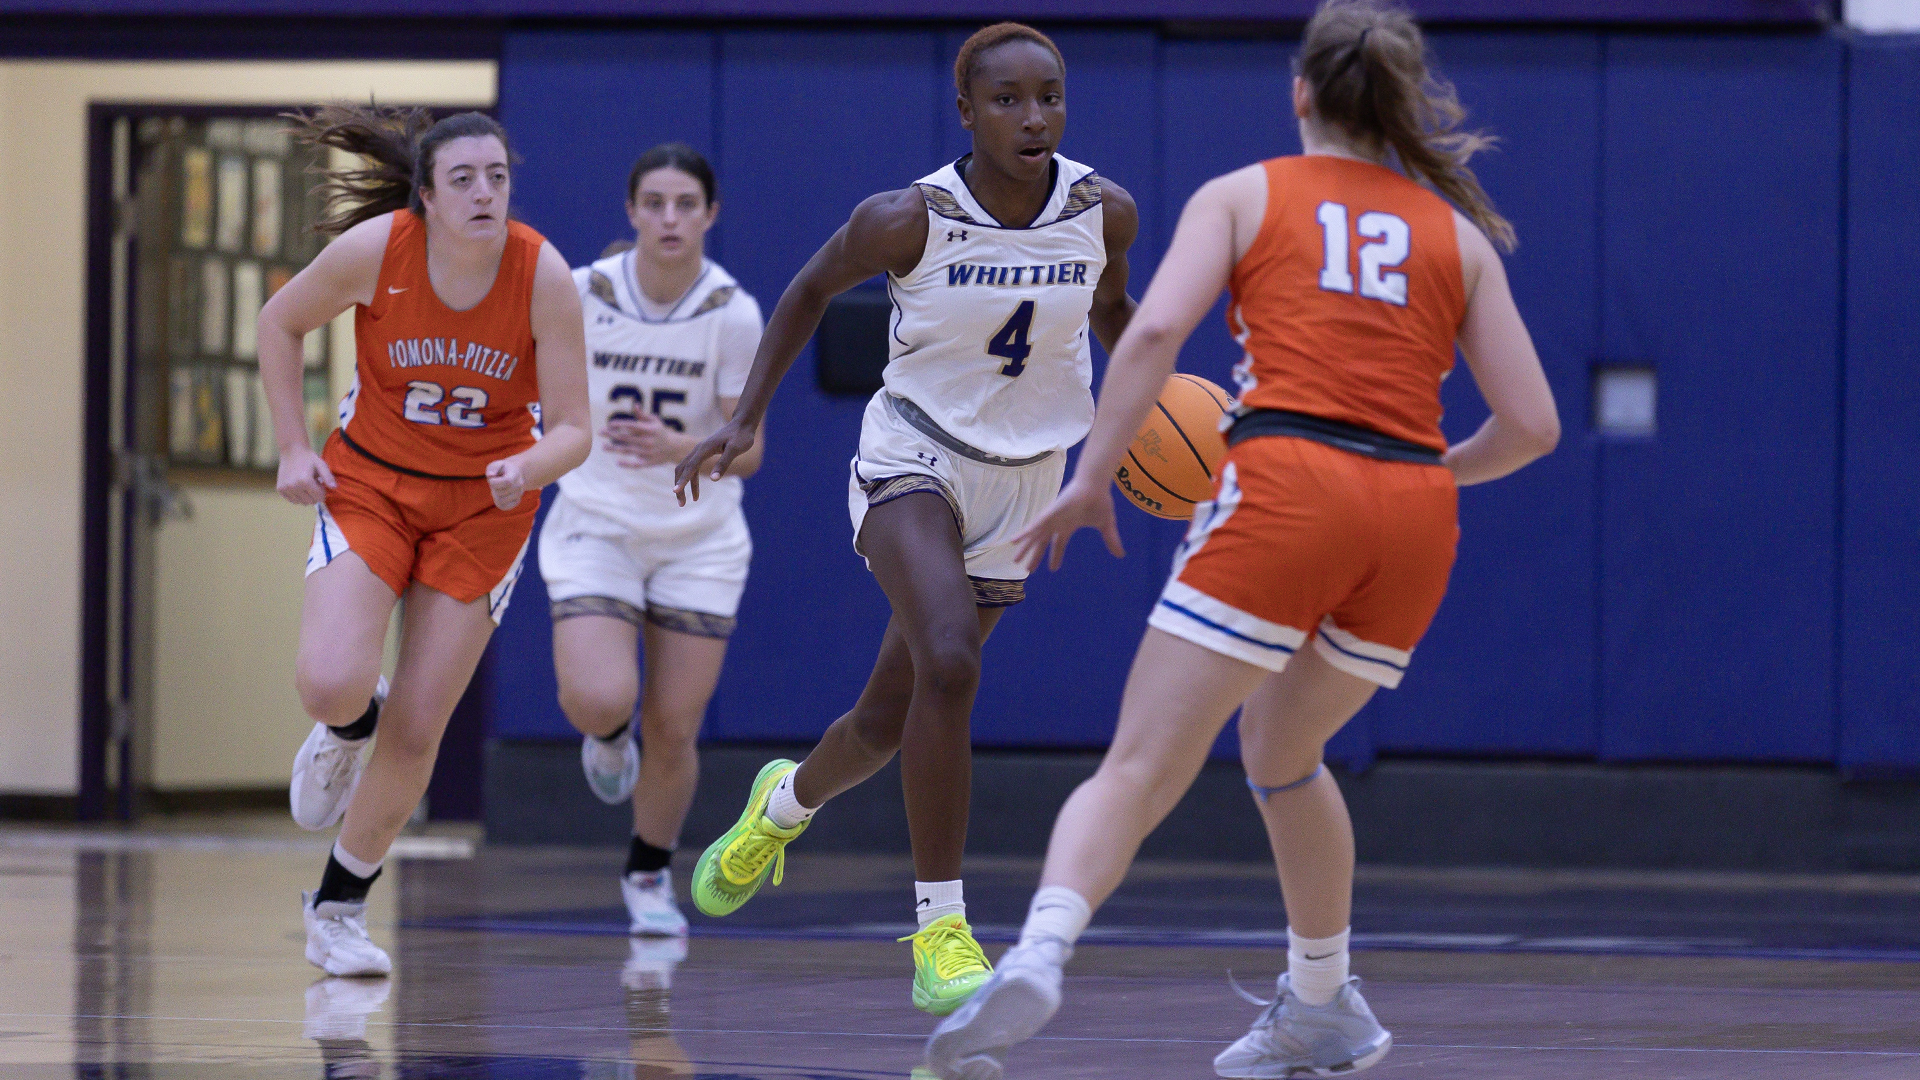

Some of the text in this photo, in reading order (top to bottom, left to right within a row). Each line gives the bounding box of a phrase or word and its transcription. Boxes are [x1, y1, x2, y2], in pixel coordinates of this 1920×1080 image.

[947, 262, 1088, 287] WHITTIER
[1315, 199, 1412, 308] 12
[985, 297, 1037, 379] 4
[592, 351, 707, 378] WHITTIER
[403, 380, 489, 429] 22
[607, 384, 687, 446] 25
[1115, 465, 1163, 511] lson
